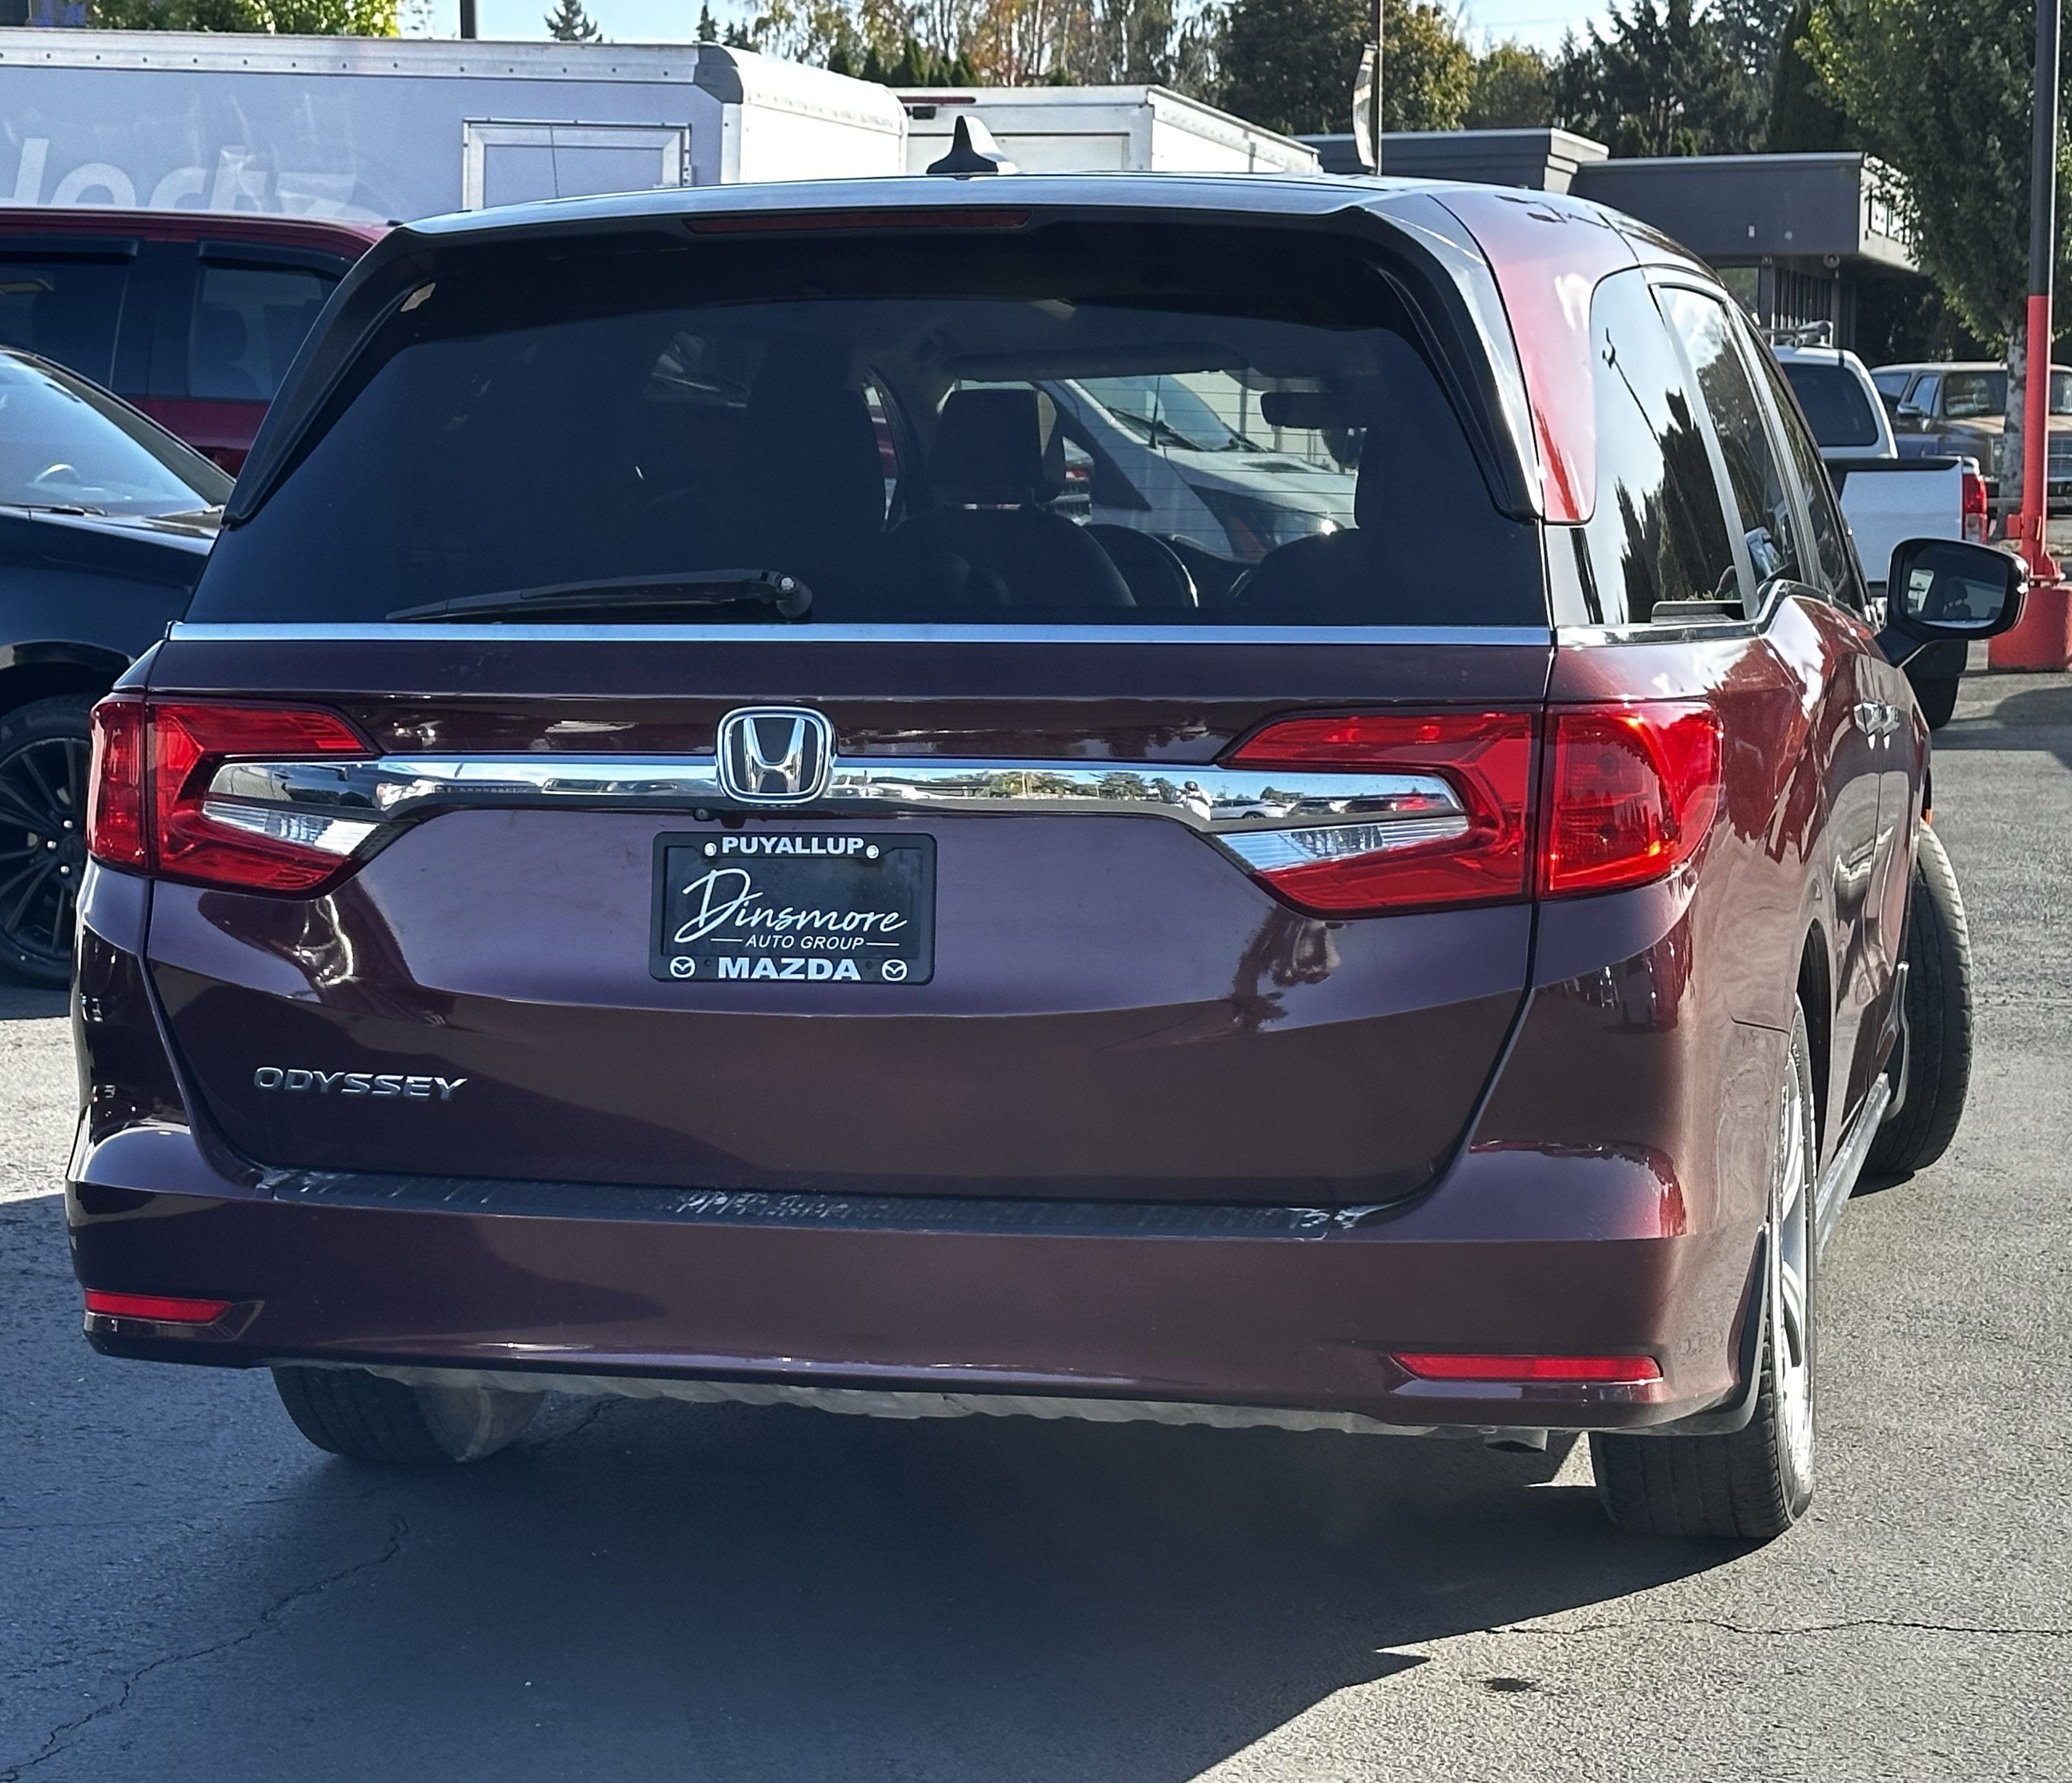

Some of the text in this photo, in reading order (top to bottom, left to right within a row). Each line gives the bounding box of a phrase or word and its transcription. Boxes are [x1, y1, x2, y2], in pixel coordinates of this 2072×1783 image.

[721, 837, 864, 855] PUYALLUP
[674, 868, 908, 943] Dinsmore
[745, 934, 864, 951] AUTO GROUP
[717, 957, 862, 981] MAZDA
[253, 1066, 468, 1101] ODYSSEY
